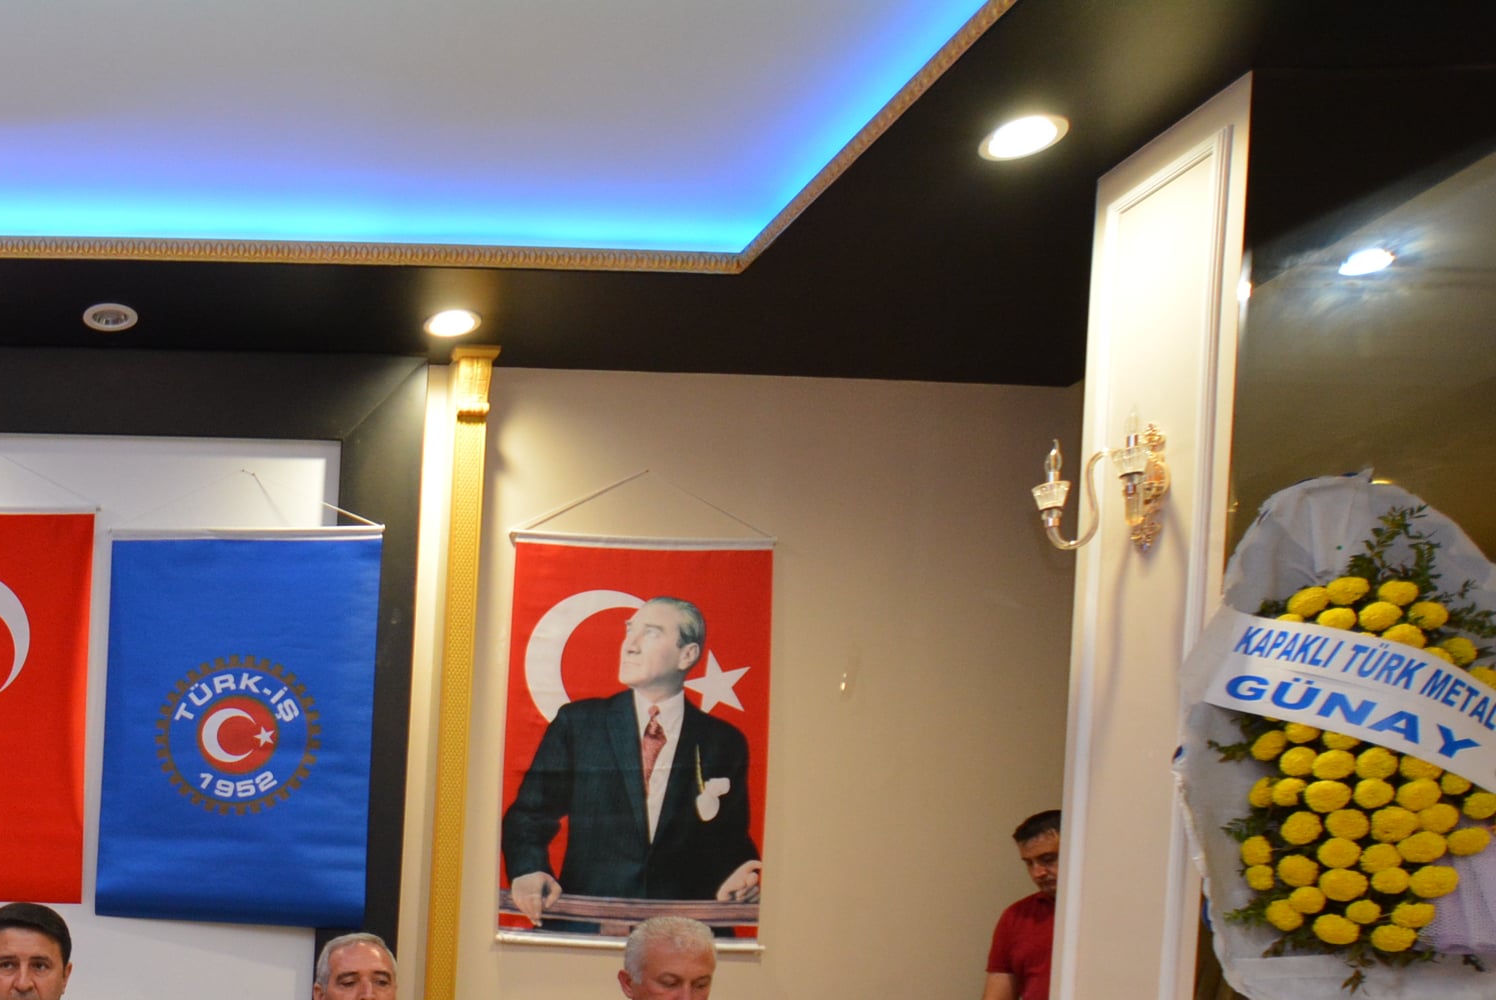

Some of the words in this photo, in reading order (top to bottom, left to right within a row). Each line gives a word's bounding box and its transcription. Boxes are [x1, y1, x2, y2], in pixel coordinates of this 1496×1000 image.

[1233, 626, 1345, 669] KAPAKLI
[1342, 643, 1427, 690] TÜRK
[174, 673, 300, 723] TÜRK-İŞ
[1226, 675, 1482, 758] GÜNAY
[200, 771, 278, 798] 1952
